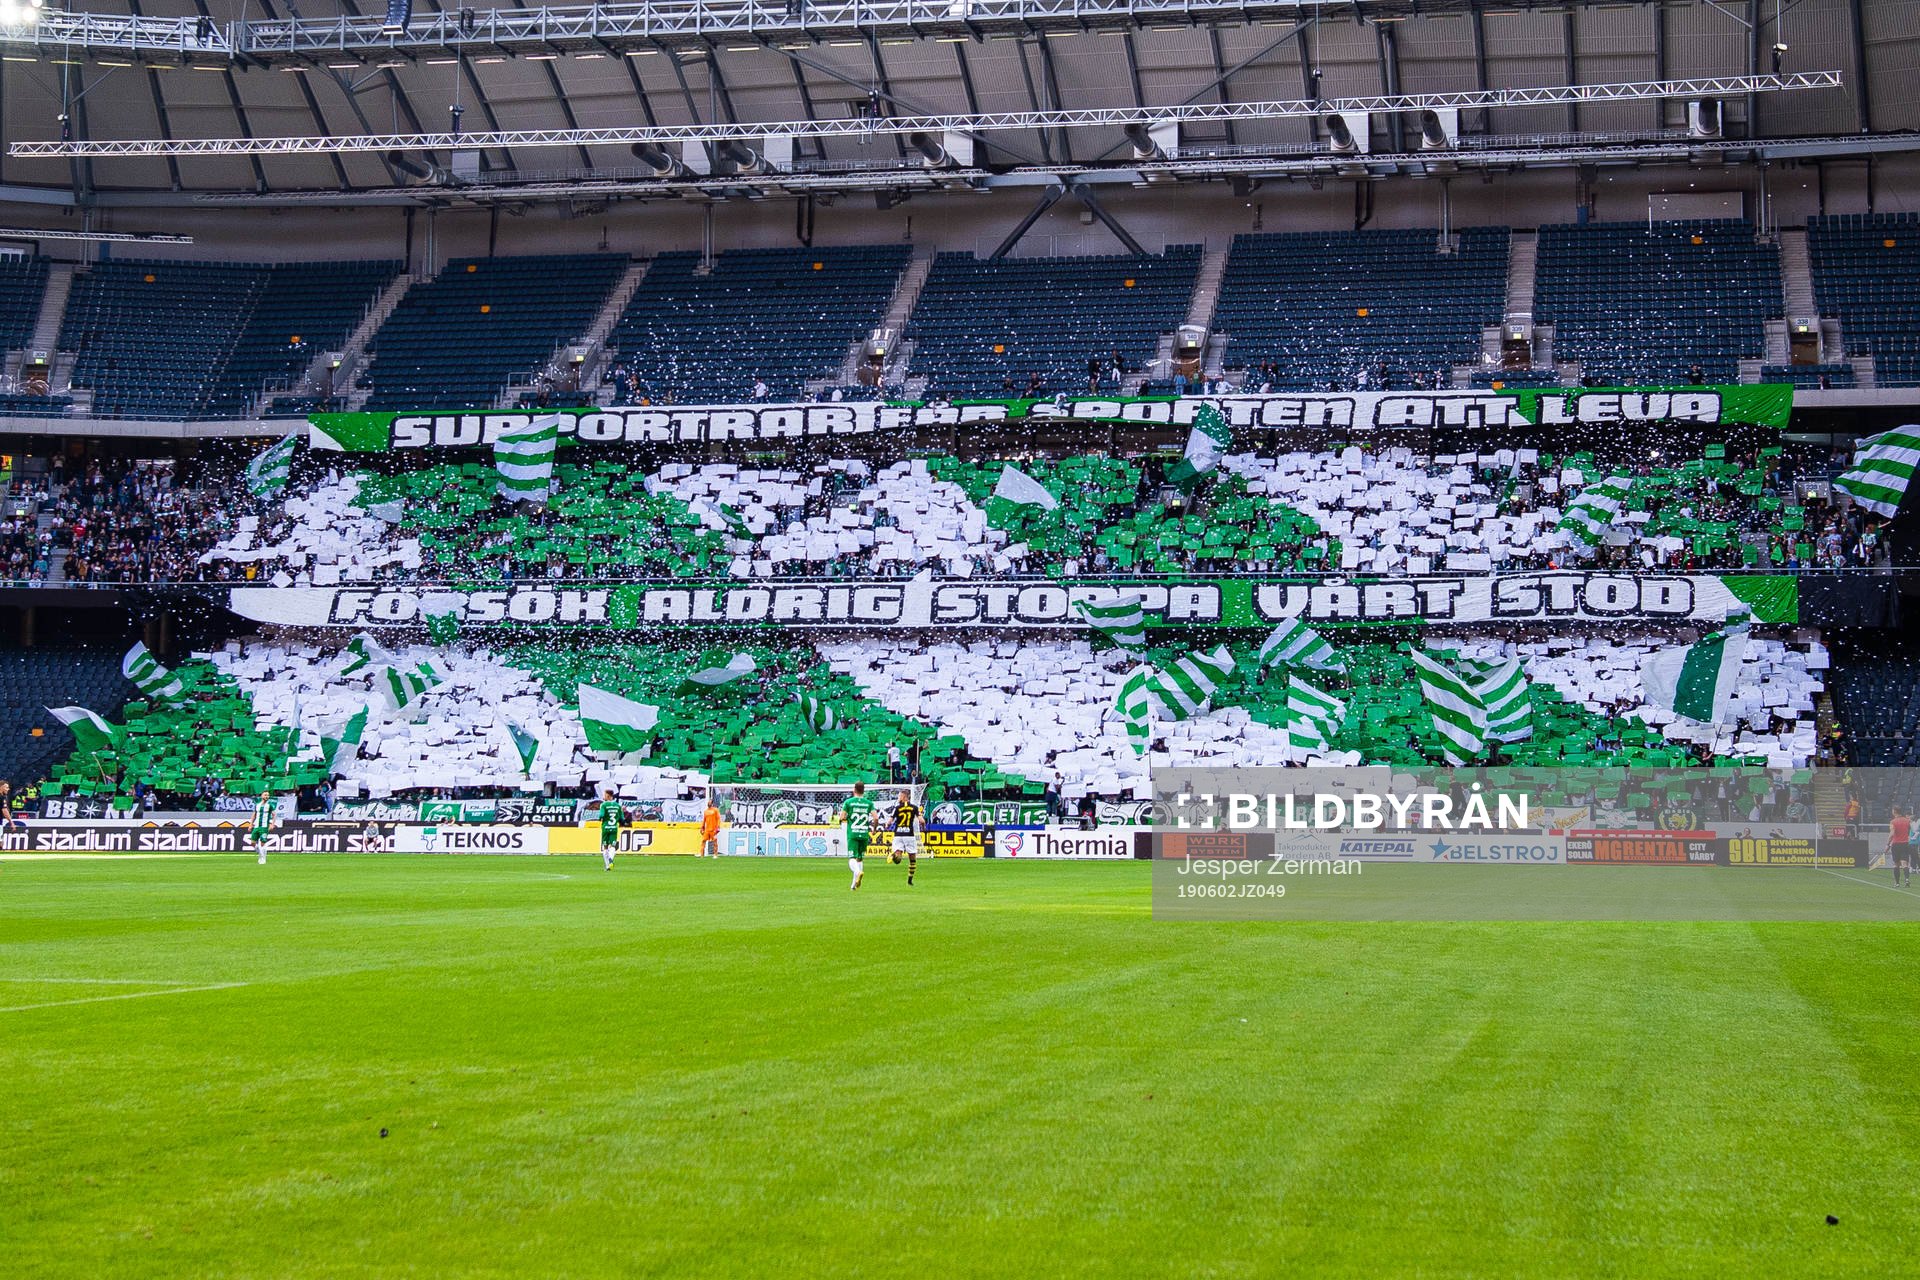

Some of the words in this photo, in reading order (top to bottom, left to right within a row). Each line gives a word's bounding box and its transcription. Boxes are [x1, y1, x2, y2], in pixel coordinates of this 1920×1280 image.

[1377, 396, 1517, 428] ATT
[643, 588, 902, 622] ALDRIG
[1257, 577, 1462, 618] VÅRT
[45, 800, 79, 818] BB
[522, 805, 533, 814] 12
[536, 805, 571, 814] YEARS
[607, 813, 617, 826] 3
[850, 813, 869, 830] 22
[898, 812, 912, 827] 21
[36, 829, 131, 850] stadium
[138, 829, 235, 851] stadium
[242, 829, 339, 851] sadium
[442, 832, 523, 848] TEKNOS
[728, 832, 828, 855] Flinks
[1031, 833, 1128, 855] Thermia
[1189, 837, 1241, 845] WORK
[1278, 842, 1331, 852] Takprodukter
[1567, 840, 1592, 849] EKERÖ
[1340, 842, 1415, 853] KATEPAL
[1450, 845, 1558, 861] BELSTROJ
[1567, 850, 1593, 859] SOLNA
[1729, 839, 1768, 863] SBG
[1770, 847, 1815, 855] SANERING
[1318, 852, 1332, 860] AB
[1689, 850, 1715, 860] VÅRBY
[1770, 855, 1856, 864] MILJÖINVENTERING
